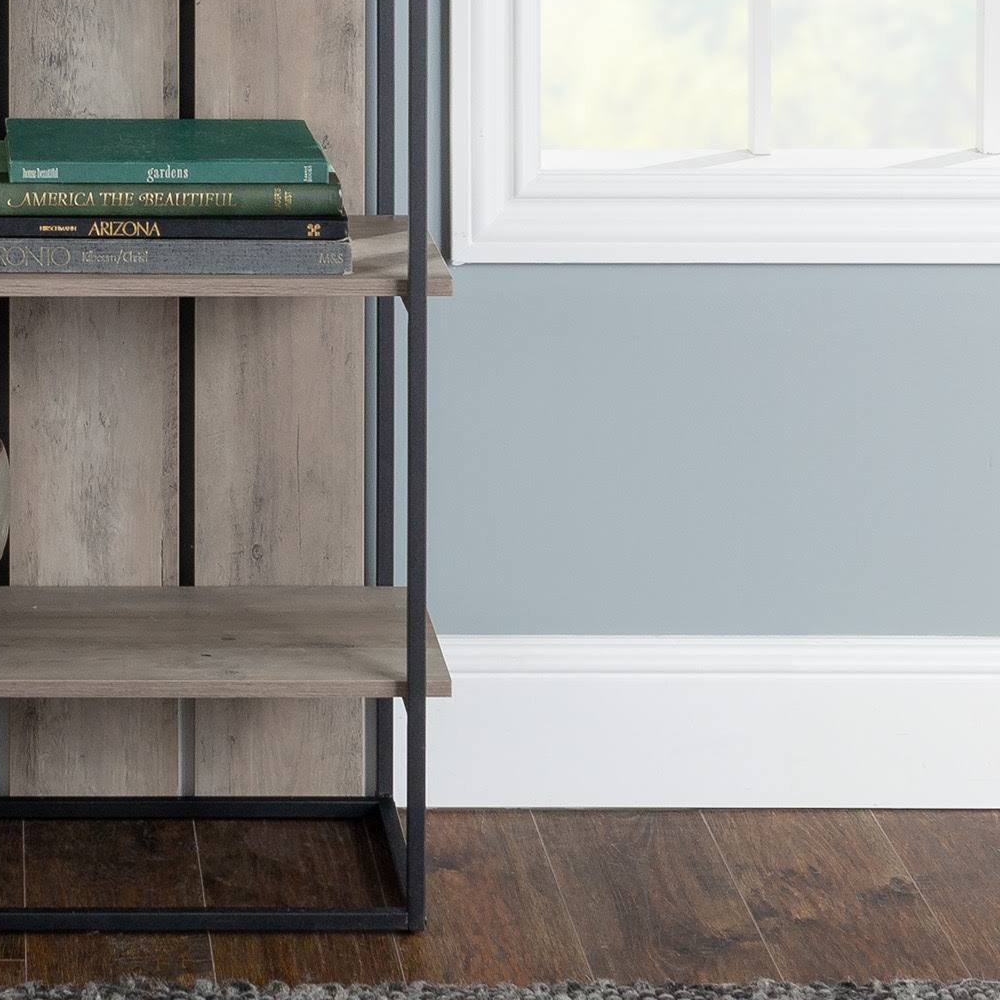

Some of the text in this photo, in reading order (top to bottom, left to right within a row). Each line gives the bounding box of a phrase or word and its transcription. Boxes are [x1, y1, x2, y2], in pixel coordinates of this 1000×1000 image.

[146, 164, 189, 183] gardens
[7, 191, 237, 208] AMERICA THE BEAUTIFUL
[87, 220, 161, 237] ARIZONA
